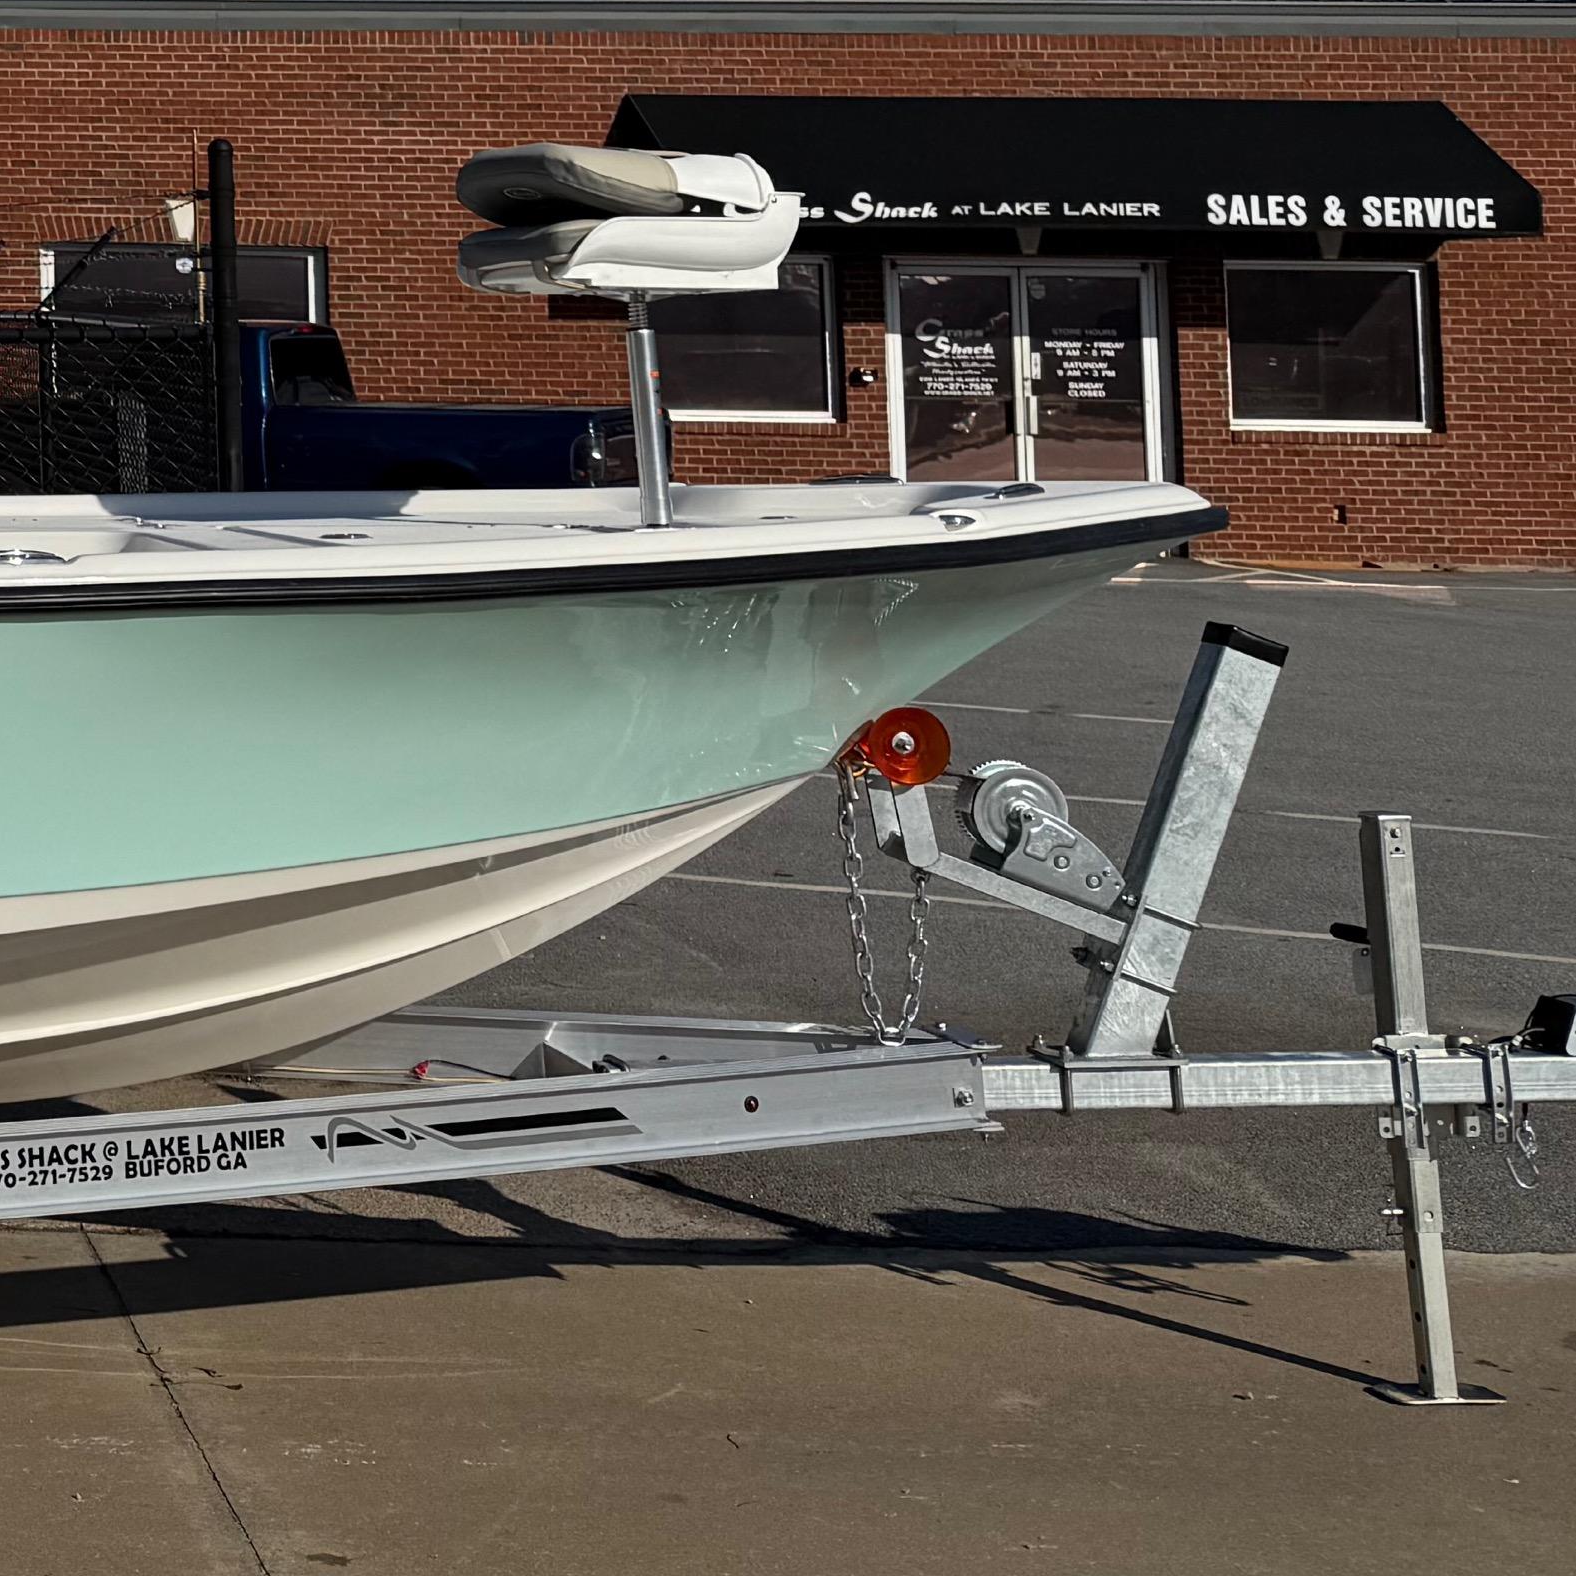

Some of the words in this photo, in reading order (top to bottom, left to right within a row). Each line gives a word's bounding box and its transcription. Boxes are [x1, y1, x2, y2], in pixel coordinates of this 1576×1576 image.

[834, 191, 939, 224] Shack
[951, 204, 974, 216] AT
[979, 201, 1051, 216] LAKE
[1063, 202, 1161, 217] LANIER
[1206, 193, 1308, 226] SALES
[1323, 195, 1348, 227] &
[1362, 196, 1497, 229] SERVICE
[1067, 389, 1106, 398] CLOSED
[17, 1142, 96, 1169] SHACK
[103, 1140, 119, 1162] @
[126, 1135, 190, 1161] LAKE
[197, 1127, 285, 1155] LANIER
[124, 1157, 210, 1180] BUFORD
[217, 1152, 248, 1171] GA
